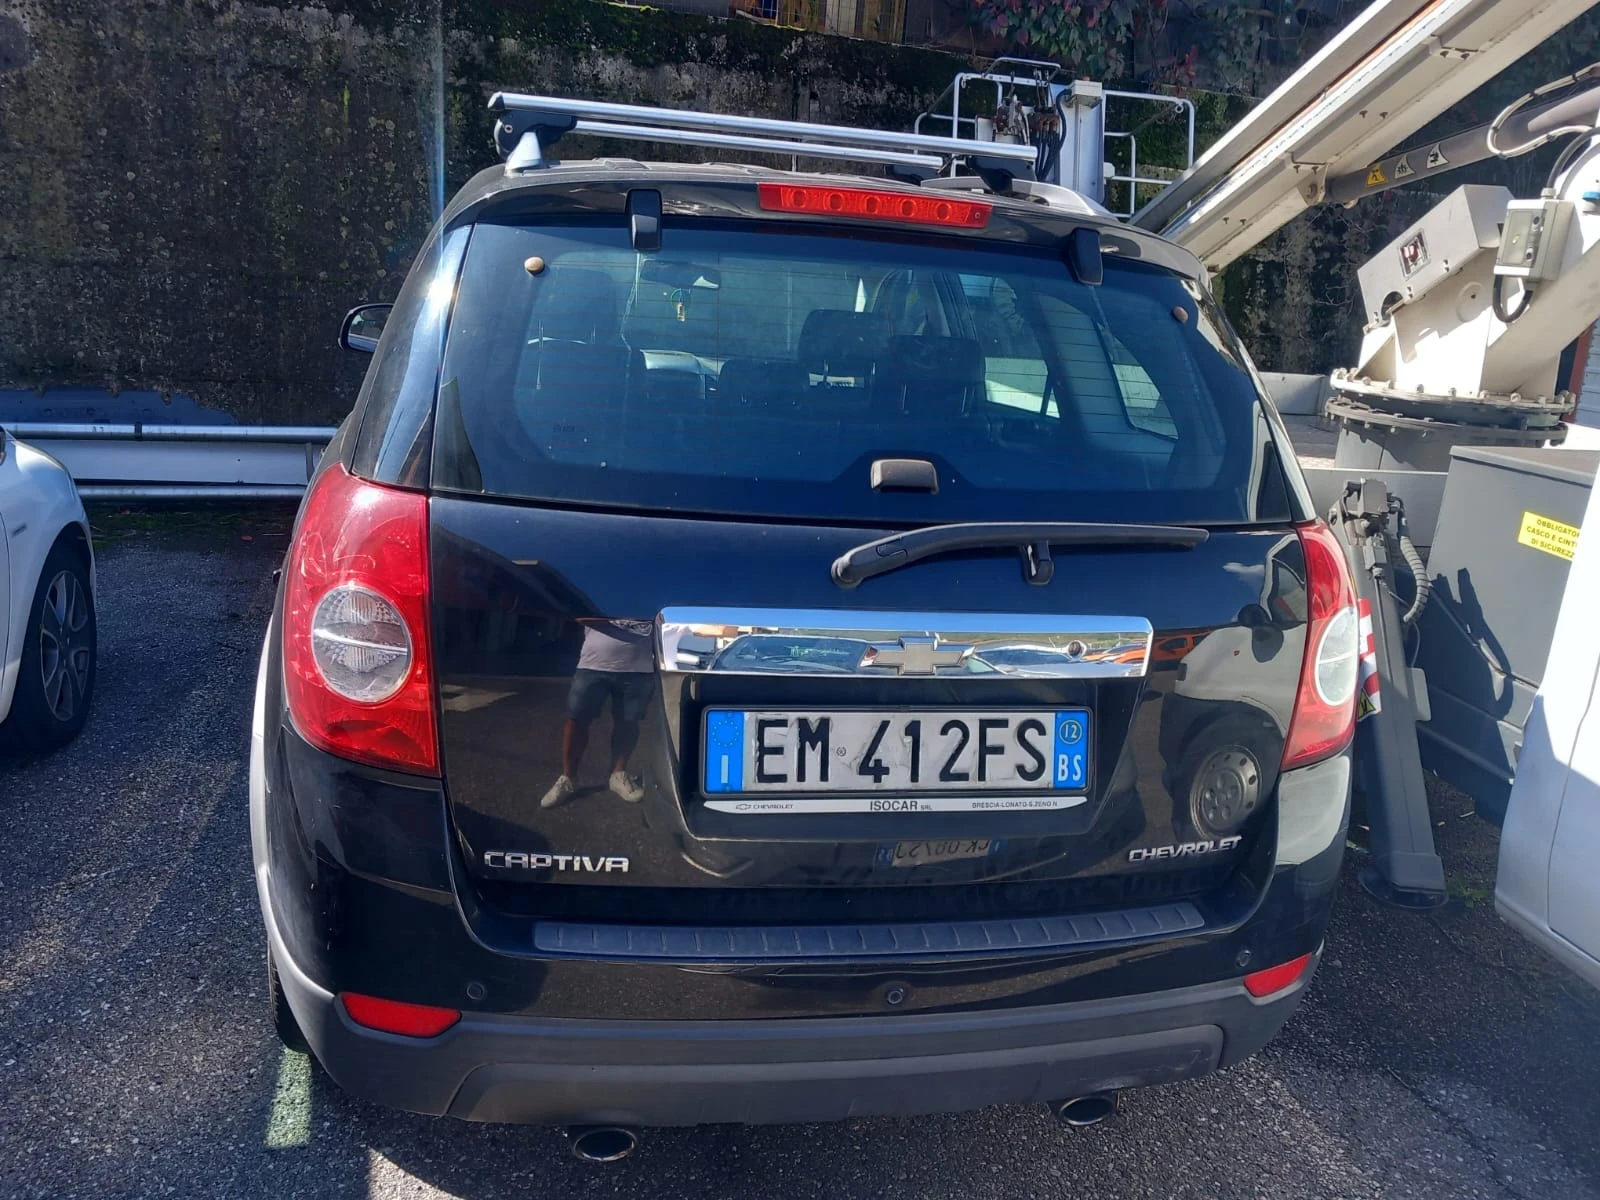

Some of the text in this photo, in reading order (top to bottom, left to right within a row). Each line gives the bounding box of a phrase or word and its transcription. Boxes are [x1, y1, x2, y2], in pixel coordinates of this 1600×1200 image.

[1526, 526, 1550, 539] CASCO
[1558, 536, 1578, 548] CINT
[1065, 724, 1078, 739] 12
[757, 718, 1047, 783] EM 412FS
[1057, 753, 1082, 781] BS
[870, 800, 918, 811] ISOCAR
[1128, 835, 1242, 861] CHEVROLET
[484, 851, 630, 873] CAPTIVA
